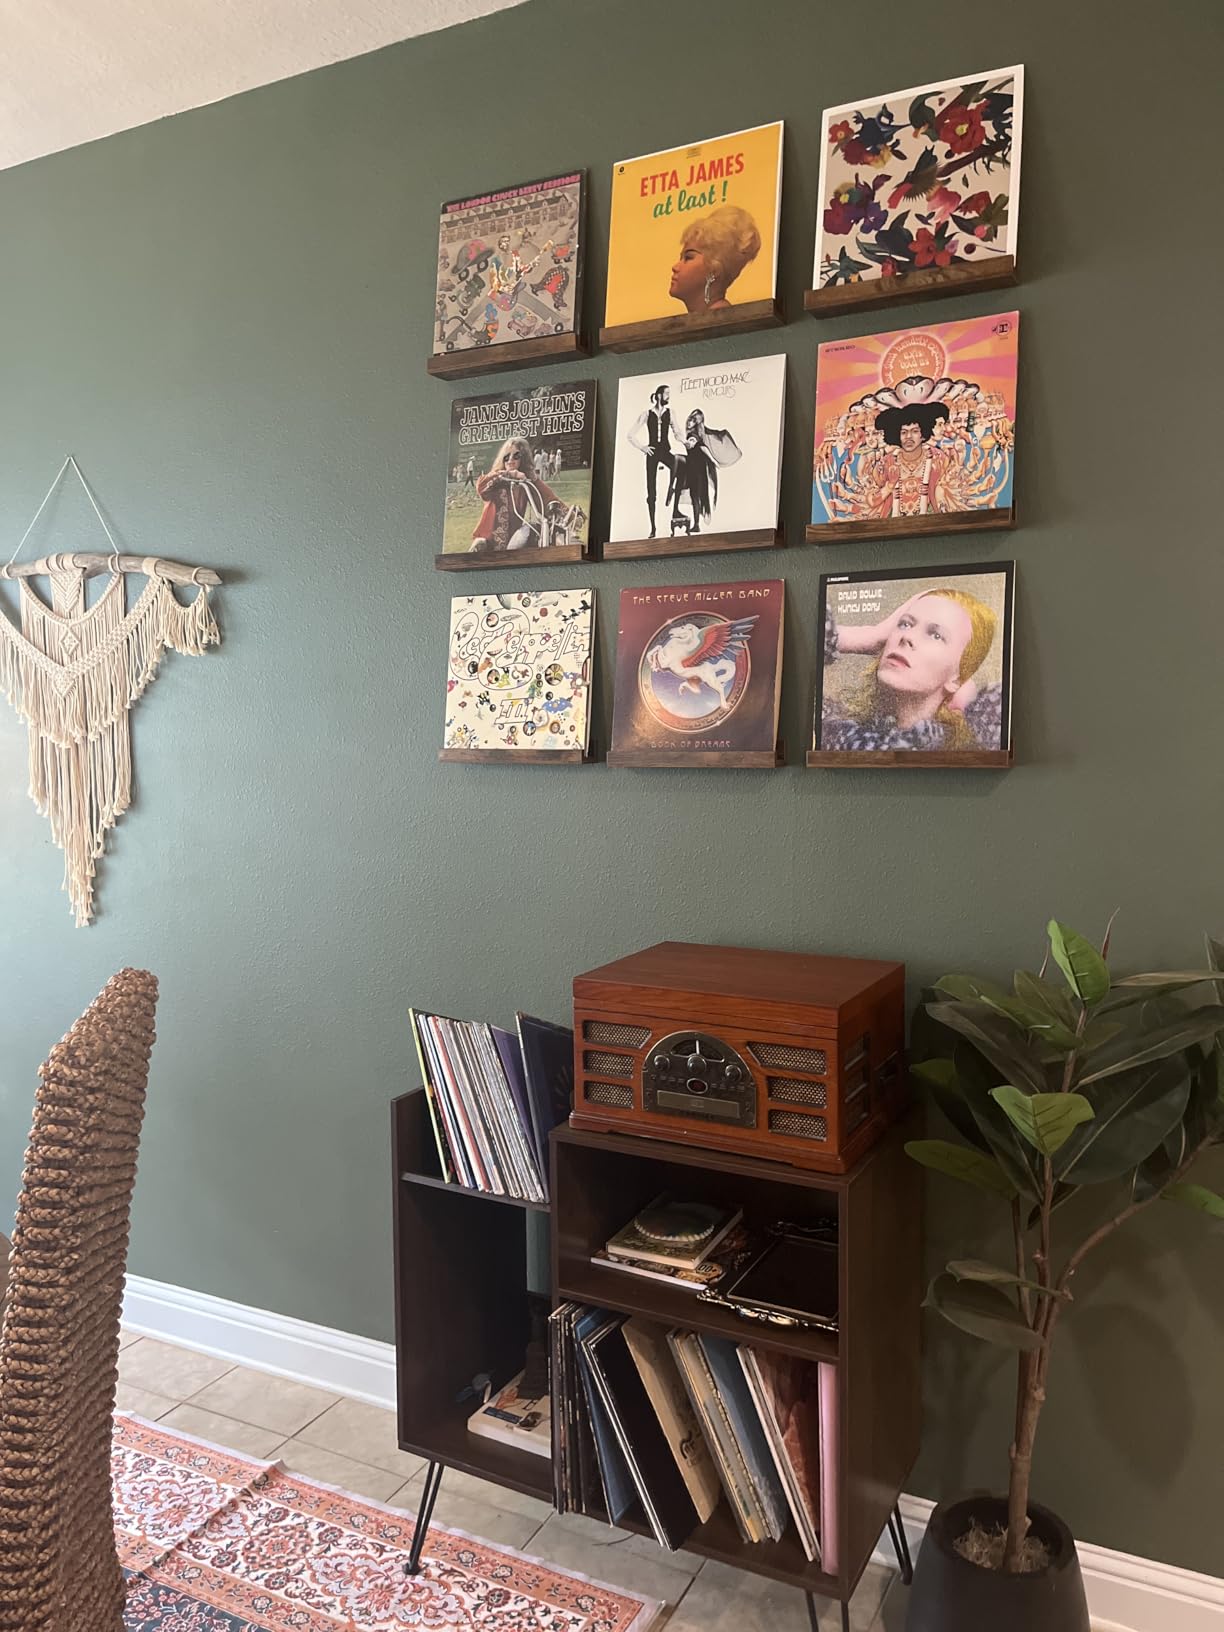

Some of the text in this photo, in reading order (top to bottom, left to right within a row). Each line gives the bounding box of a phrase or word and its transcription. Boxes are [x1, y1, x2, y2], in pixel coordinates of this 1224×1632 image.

[640, 153, 745, 197] ETTA JAMES
[461, 195, 491, 209] LONDON
[653, 195, 673, 218] at
[680, 370, 752, 393] FLEETWOOD MAC
[460, 391, 586, 426] JANIS JOPLIN'S
[458, 412, 585, 446] GREATEST HITS
[633, 588, 770, 605] THE STEVE MILLER BAND
[838, 590, 858, 601] DAVID
